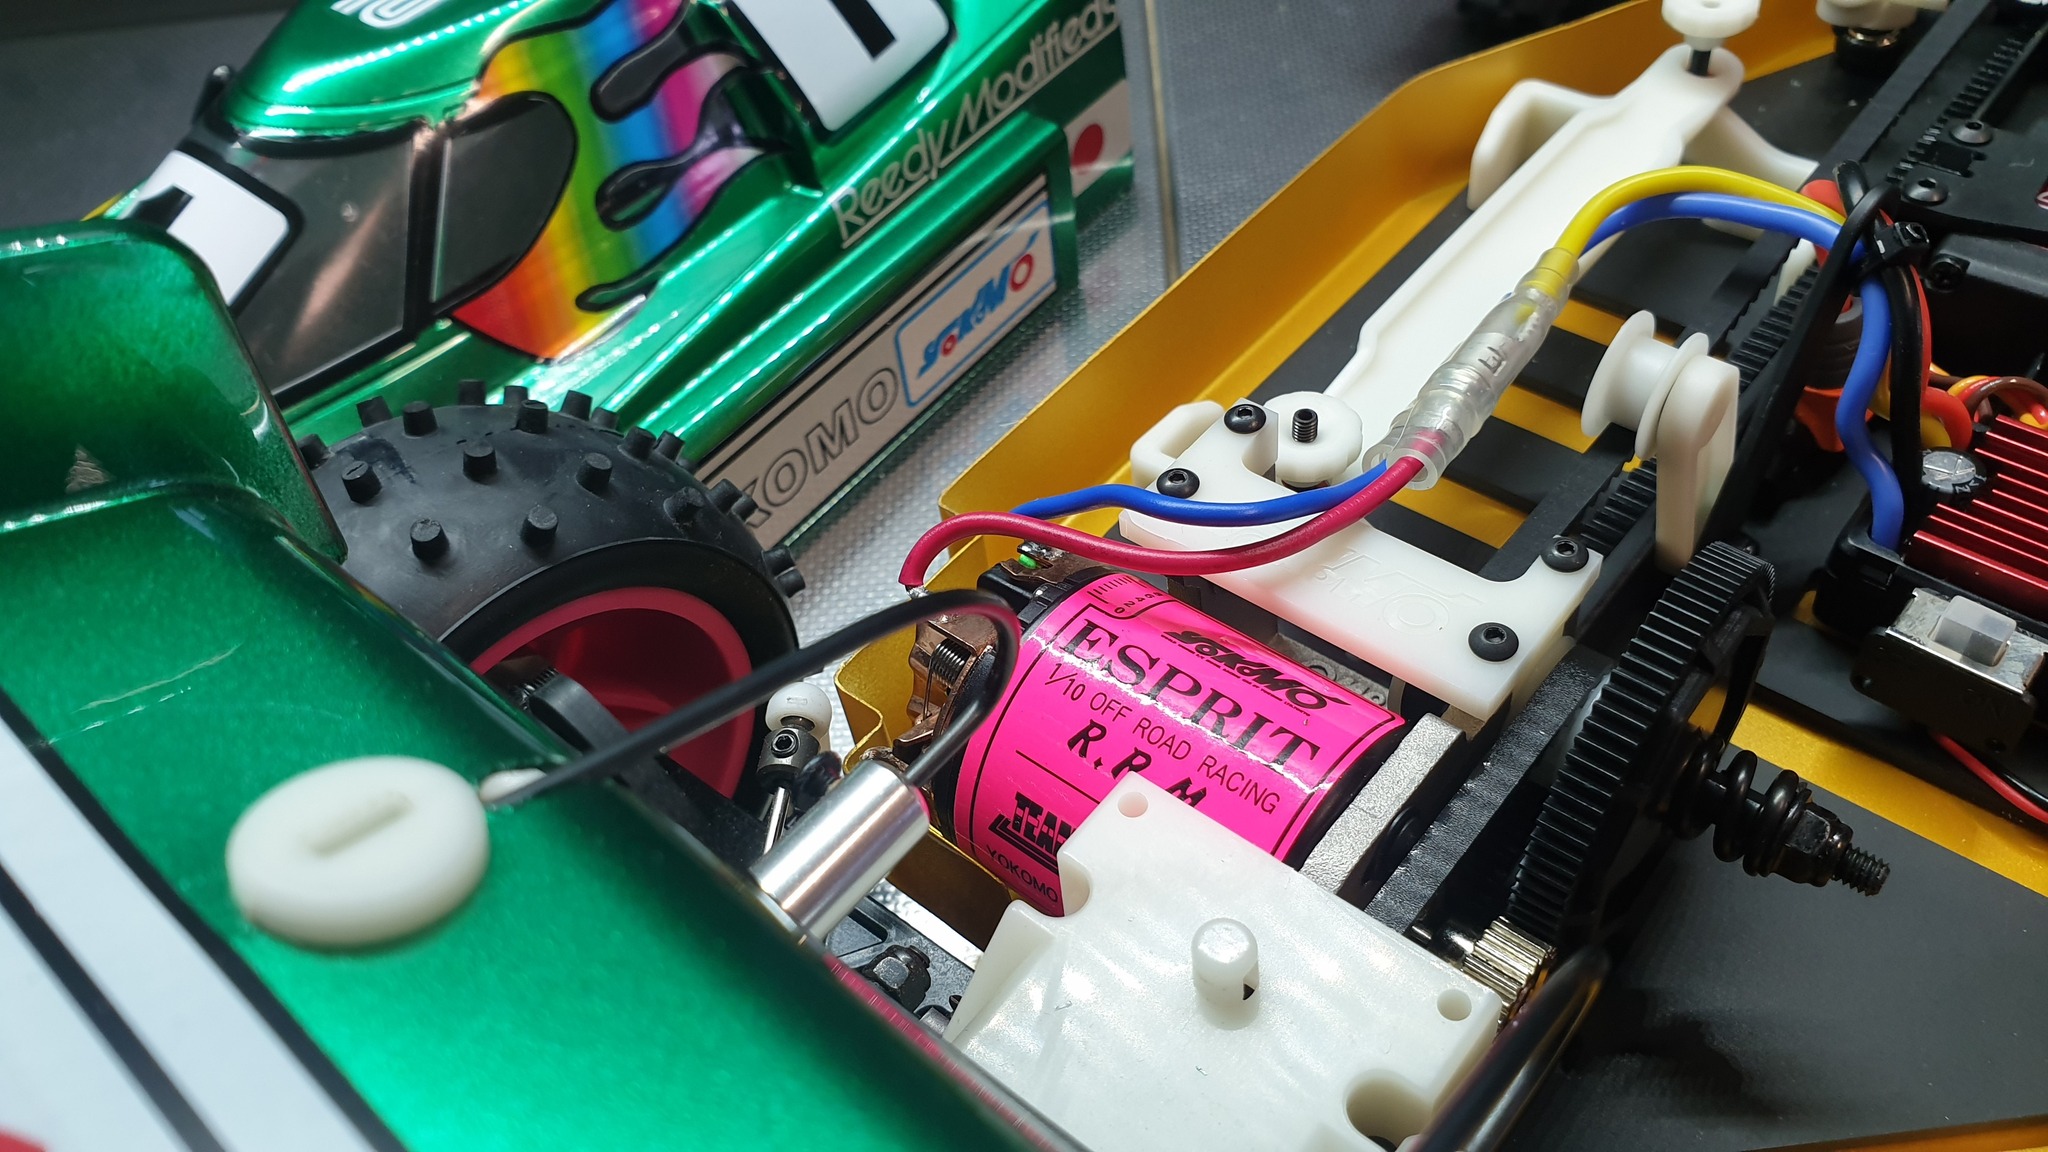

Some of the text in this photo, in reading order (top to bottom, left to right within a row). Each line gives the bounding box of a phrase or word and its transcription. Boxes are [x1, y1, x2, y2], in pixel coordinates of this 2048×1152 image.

[831, 119, 949, 242] Reedy
[1045, 663, 1280, 815] 1/10 OFF ROAD RACING
[1059, 618, 1321, 770] ESPRIT
[986, 844, 1059, 903] YOKOMO
